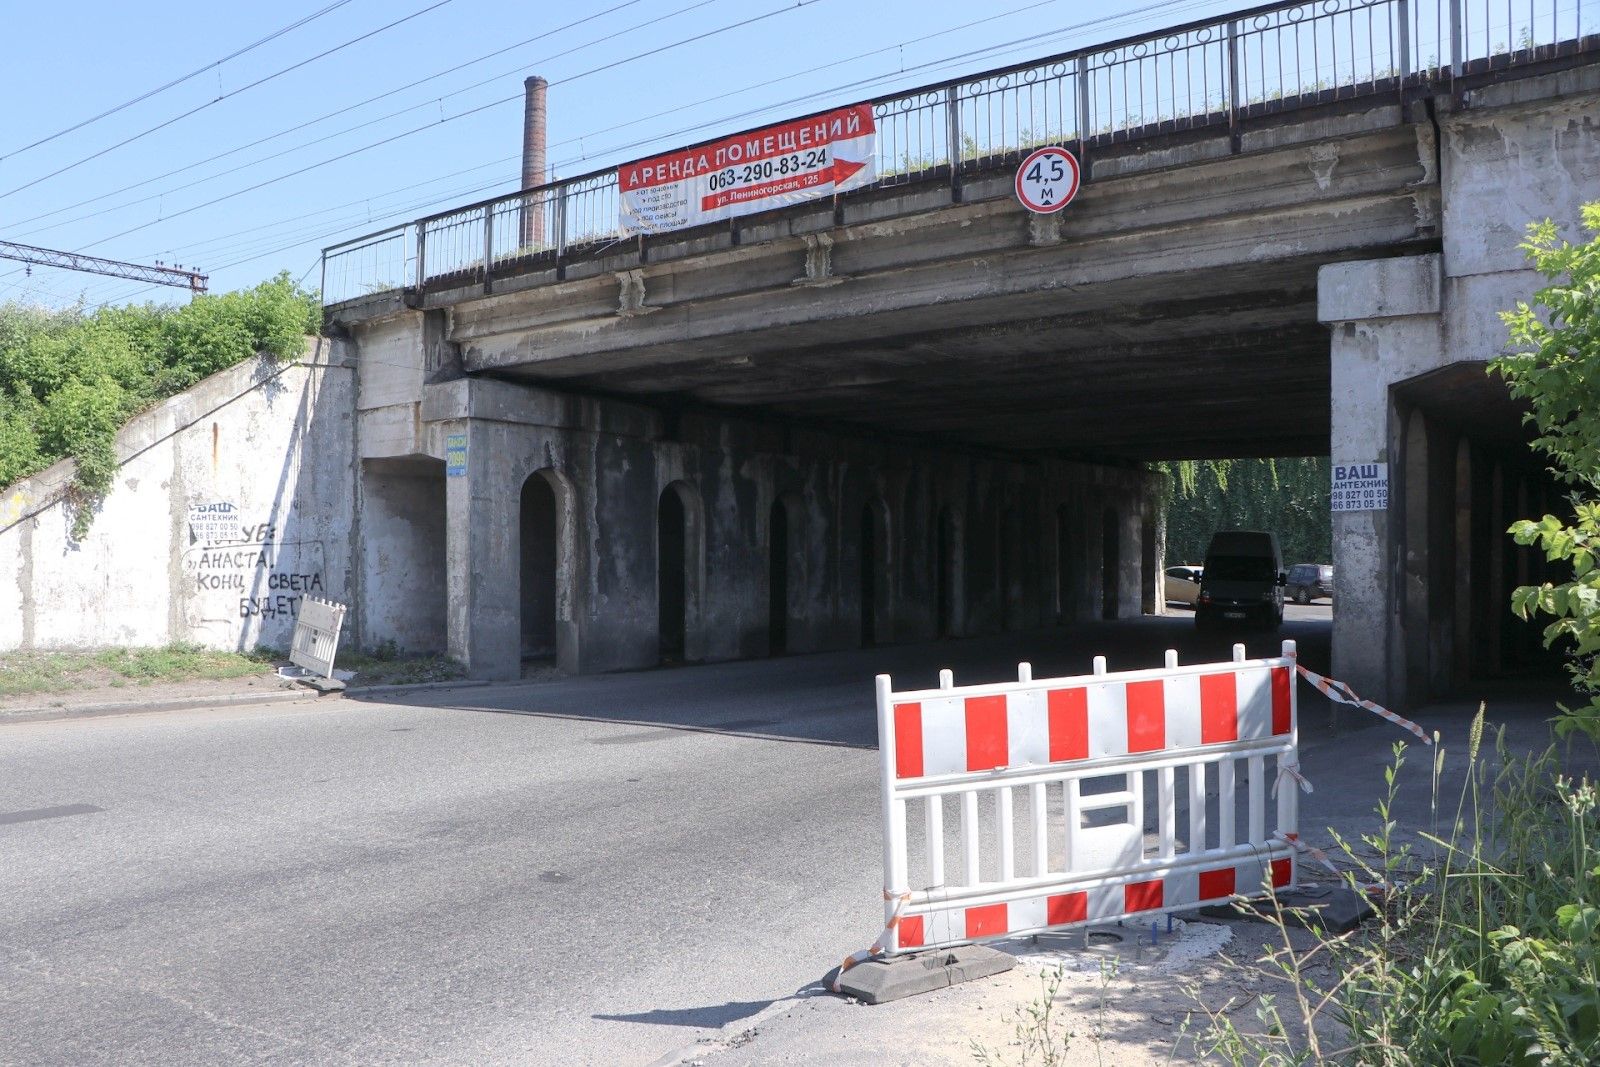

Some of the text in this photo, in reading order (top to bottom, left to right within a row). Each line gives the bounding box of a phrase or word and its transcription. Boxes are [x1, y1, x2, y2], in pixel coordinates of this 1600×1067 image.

[628, 112, 861, 187] АРЕНДА ПОМЕЩЕНИЙ
[709, 148, 827, 192] 063-290-83-24
[1026, 160, 1064, 185] 4,5
[716, 174, 819, 207] ул. Лениногорская, 125
[1041, 188, 1053, 199] М
[1335, 464, 1378, 480] ВАШ
[1332, 480, 1388, 490] АНТЕХНИК
[1332, 489, 1388, 500] 98 827 00 50
[1332, 499, 1388, 510] 66 873 05 15
[197, 572, 324, 593] КОНЦ СВЕТА
